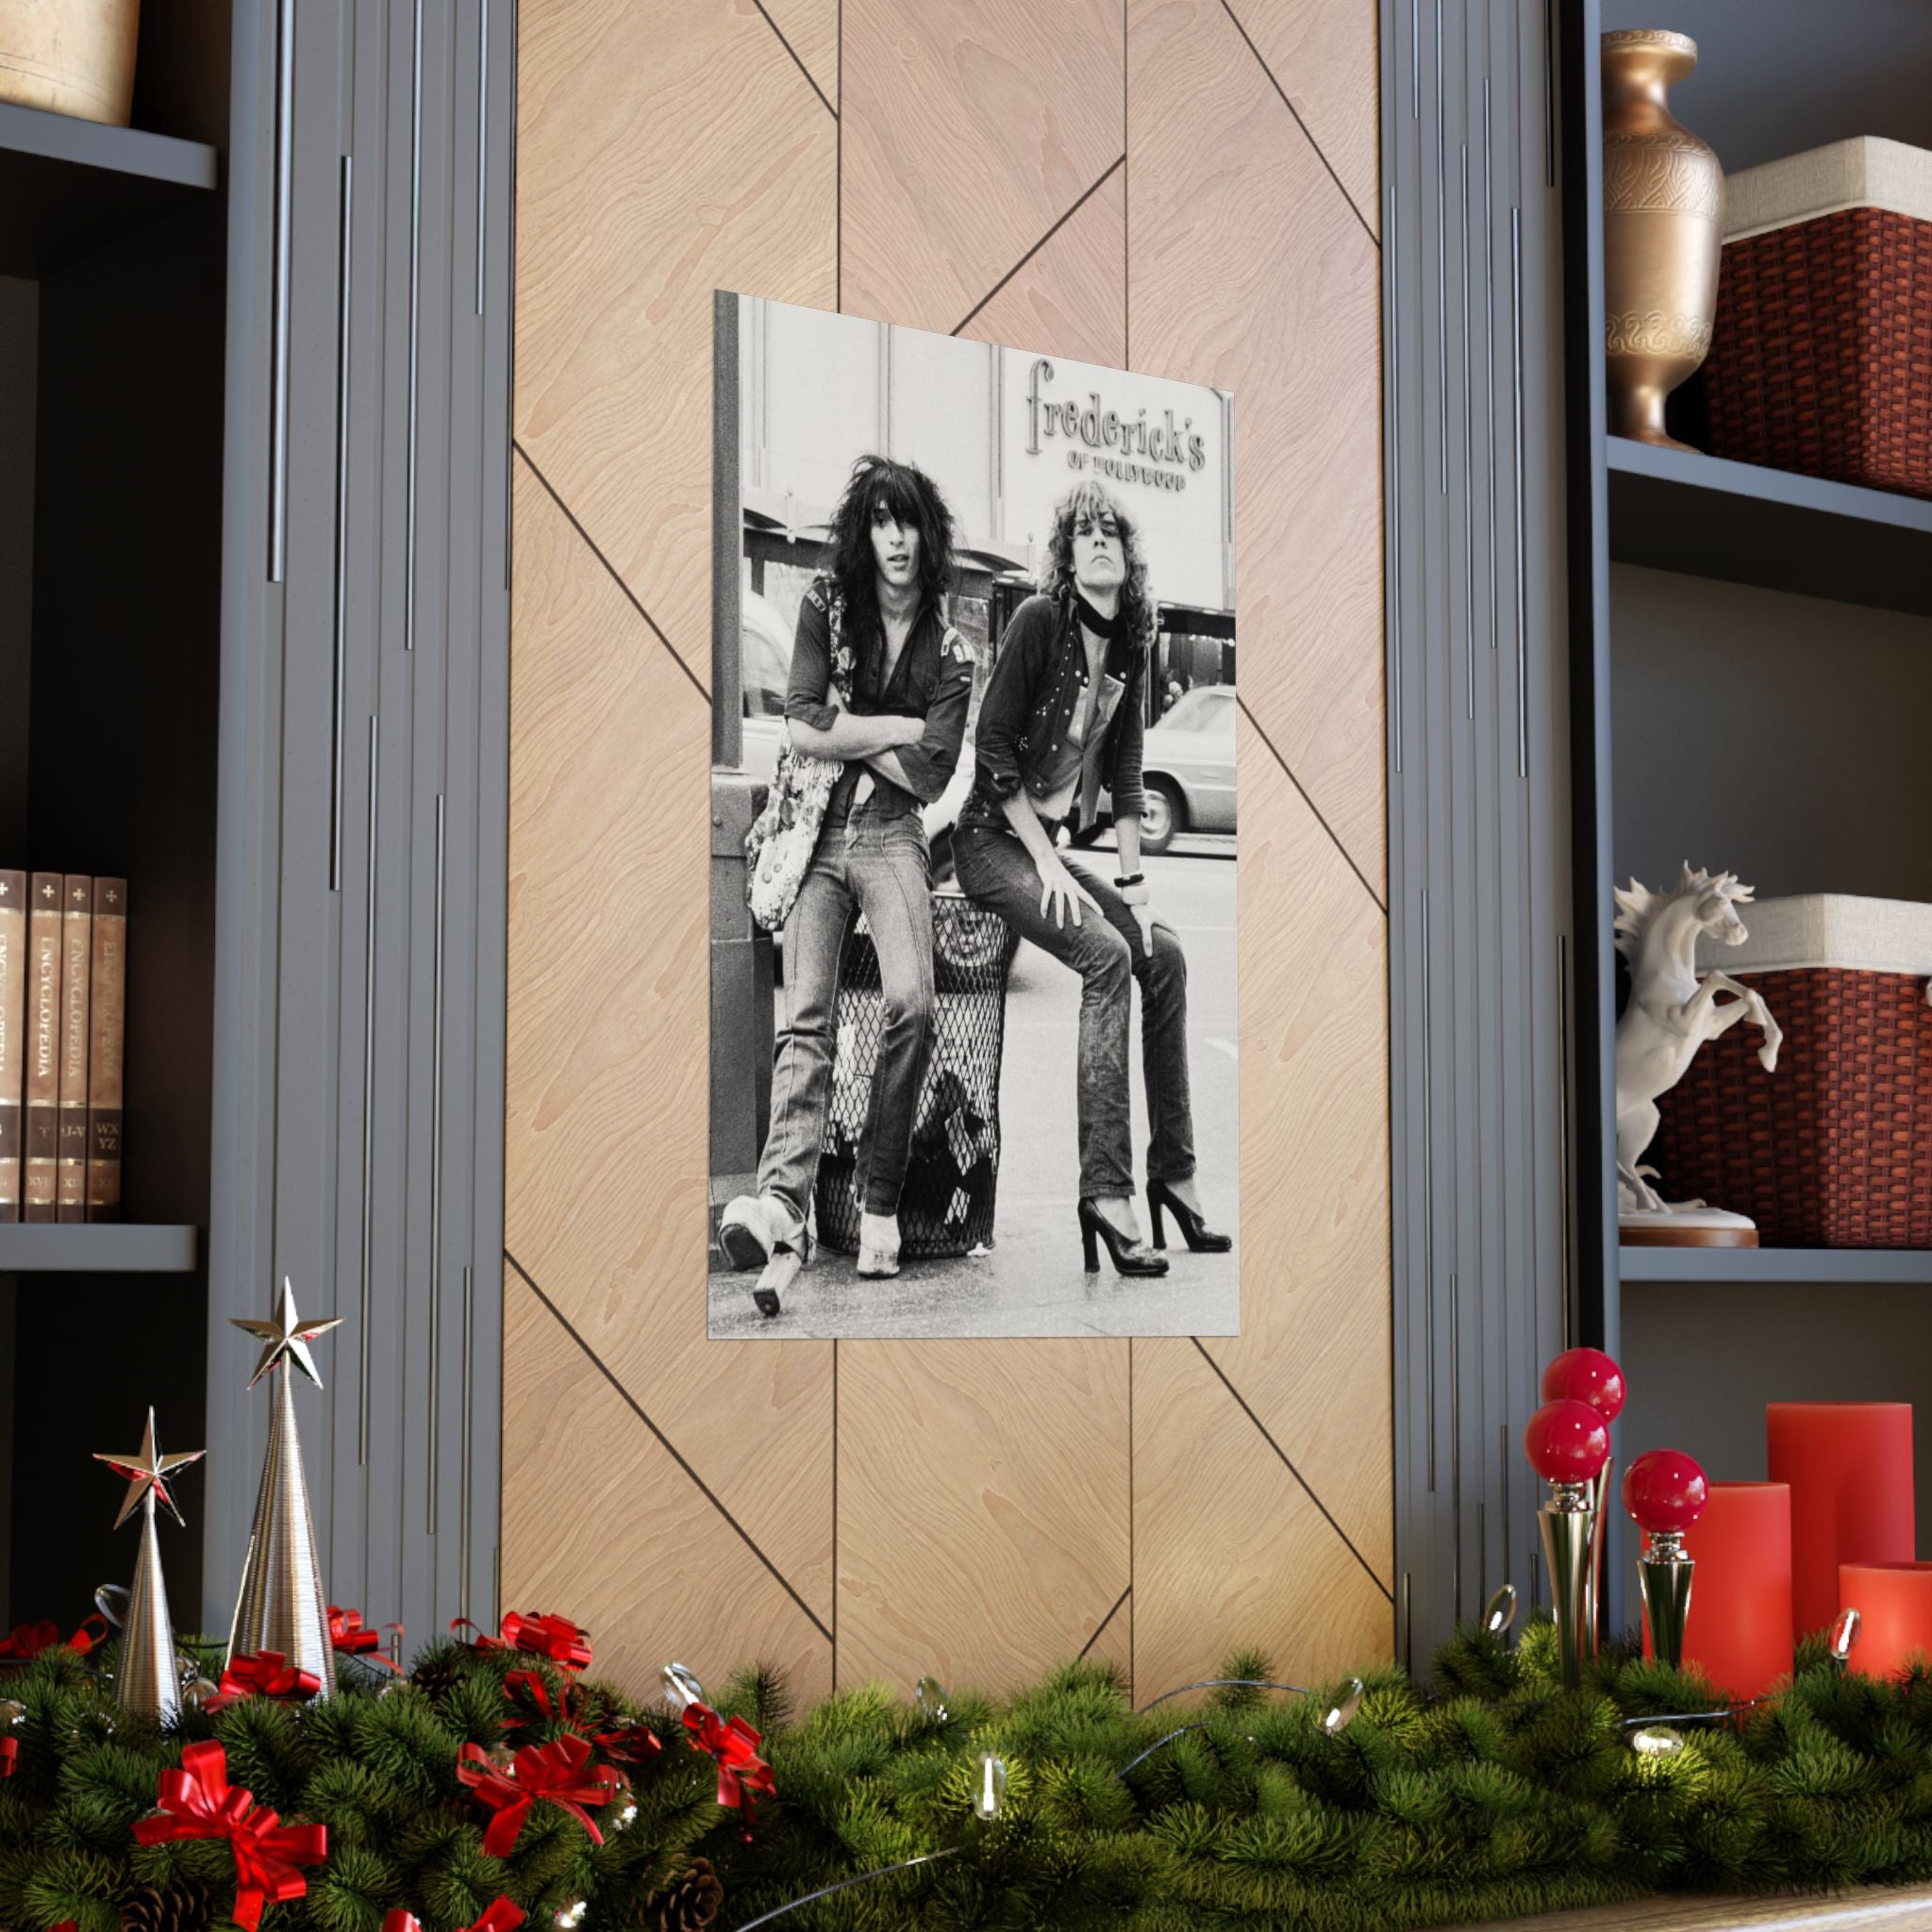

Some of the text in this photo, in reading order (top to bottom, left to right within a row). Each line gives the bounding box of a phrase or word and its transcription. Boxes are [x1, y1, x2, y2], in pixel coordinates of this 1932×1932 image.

[1025, 358, 1206, 471] frederick's
[1067, 450, 1089, 470] OF
[38, 937, 54, 1077] ENCYCLOPEDIA
[69, 938, 85, 1078] ENCYCLOPEDIA
